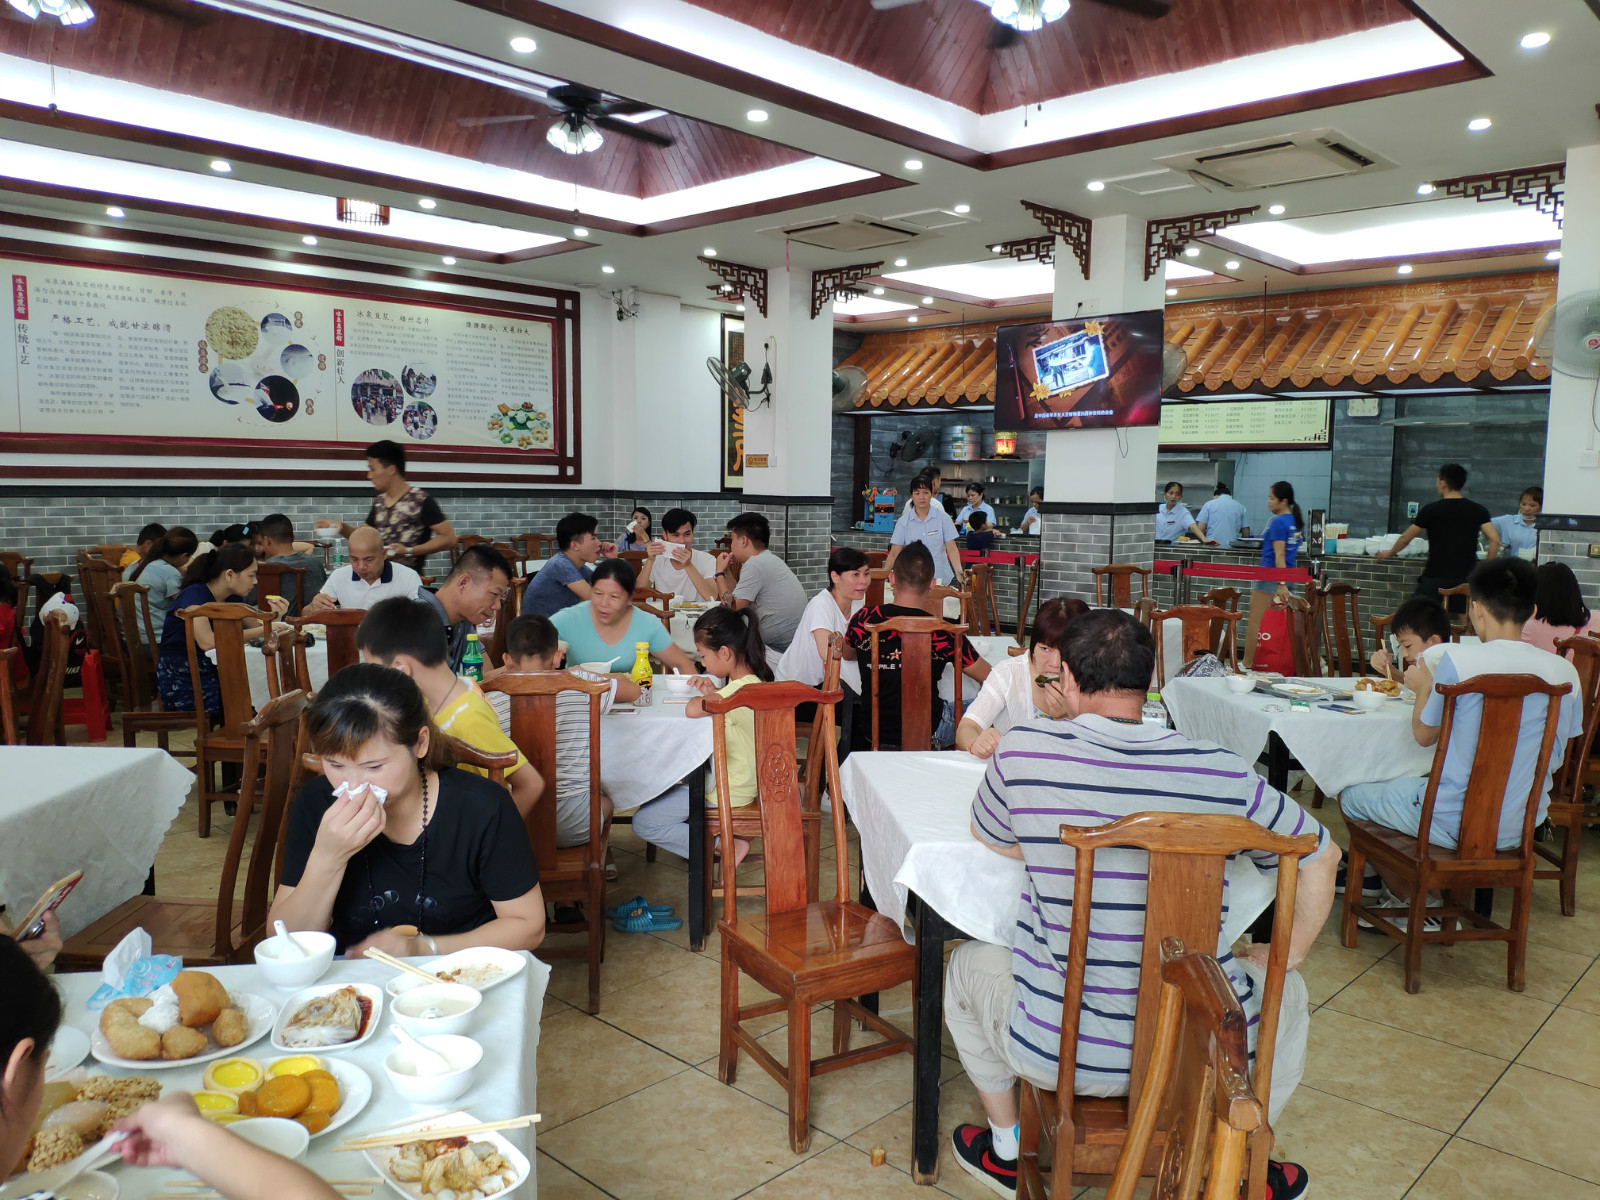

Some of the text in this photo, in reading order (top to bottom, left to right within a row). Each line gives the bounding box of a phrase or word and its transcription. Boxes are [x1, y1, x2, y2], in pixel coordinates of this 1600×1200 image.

[17, 322, 30, 366] 传统工艺
[336, 349, 345, 385] 创新壮大
